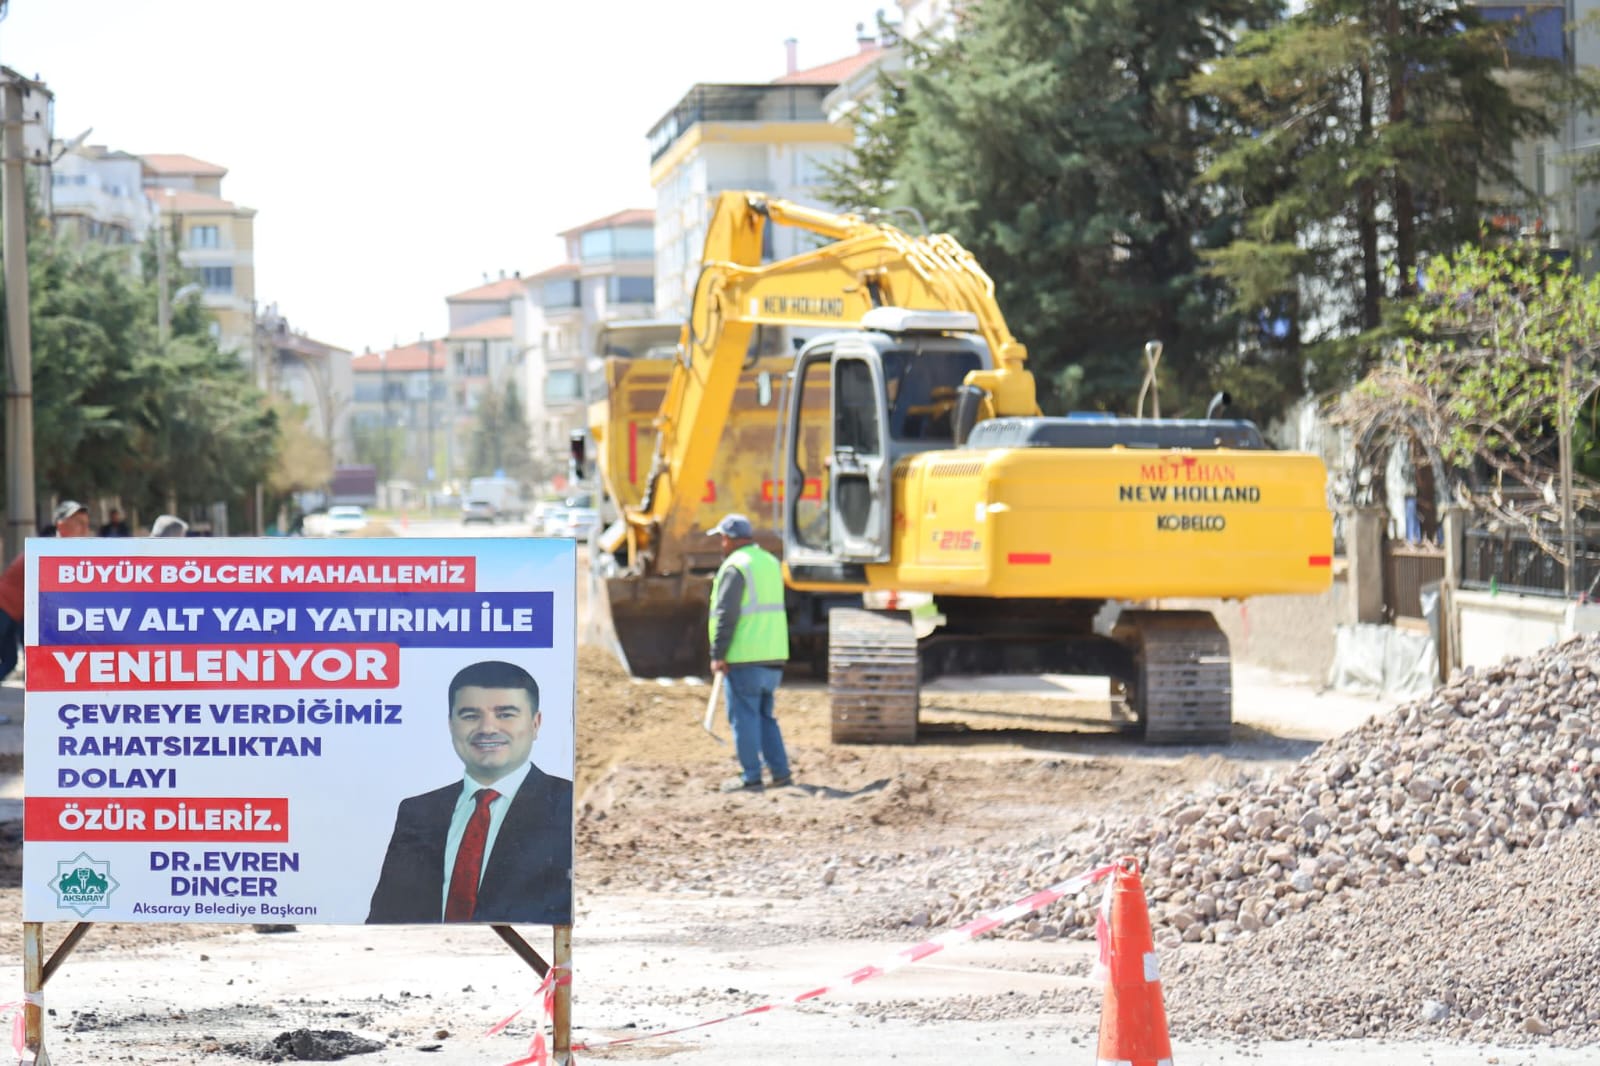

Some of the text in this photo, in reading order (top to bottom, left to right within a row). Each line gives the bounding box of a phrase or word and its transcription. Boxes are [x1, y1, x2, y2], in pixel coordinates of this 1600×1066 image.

[791, 297, 843, 317] HOLLAND
[1119, 486, 1261, 503] NEW HOLLAND
[1156, 515, 1226, 532] KOBELCO
[58, 560, 466, 584] BÜYÜK BÖLCEK MAHALLEMİZ
[58, 602, 533, 632] DEV ALT YAPI YATIRIMI İLE
[52, 649, 388, 684] YENİLENİYOR
[57, 698, 403, 729] ÇEVREYE VERDİĞİMİZ
[58, 735, 322, 757] RAHATSIZLIKTAN
[58, 768, 177, 789] DOLAYI
[58, 802, 282, 832] ÖZÜR DİLERİZ.
[62, 894, 105, 902] AKSARAY
[170, 876, 278, 898] DİNÇER
[132, 902, 317, 918] Aksaray Belediye Başkanı
